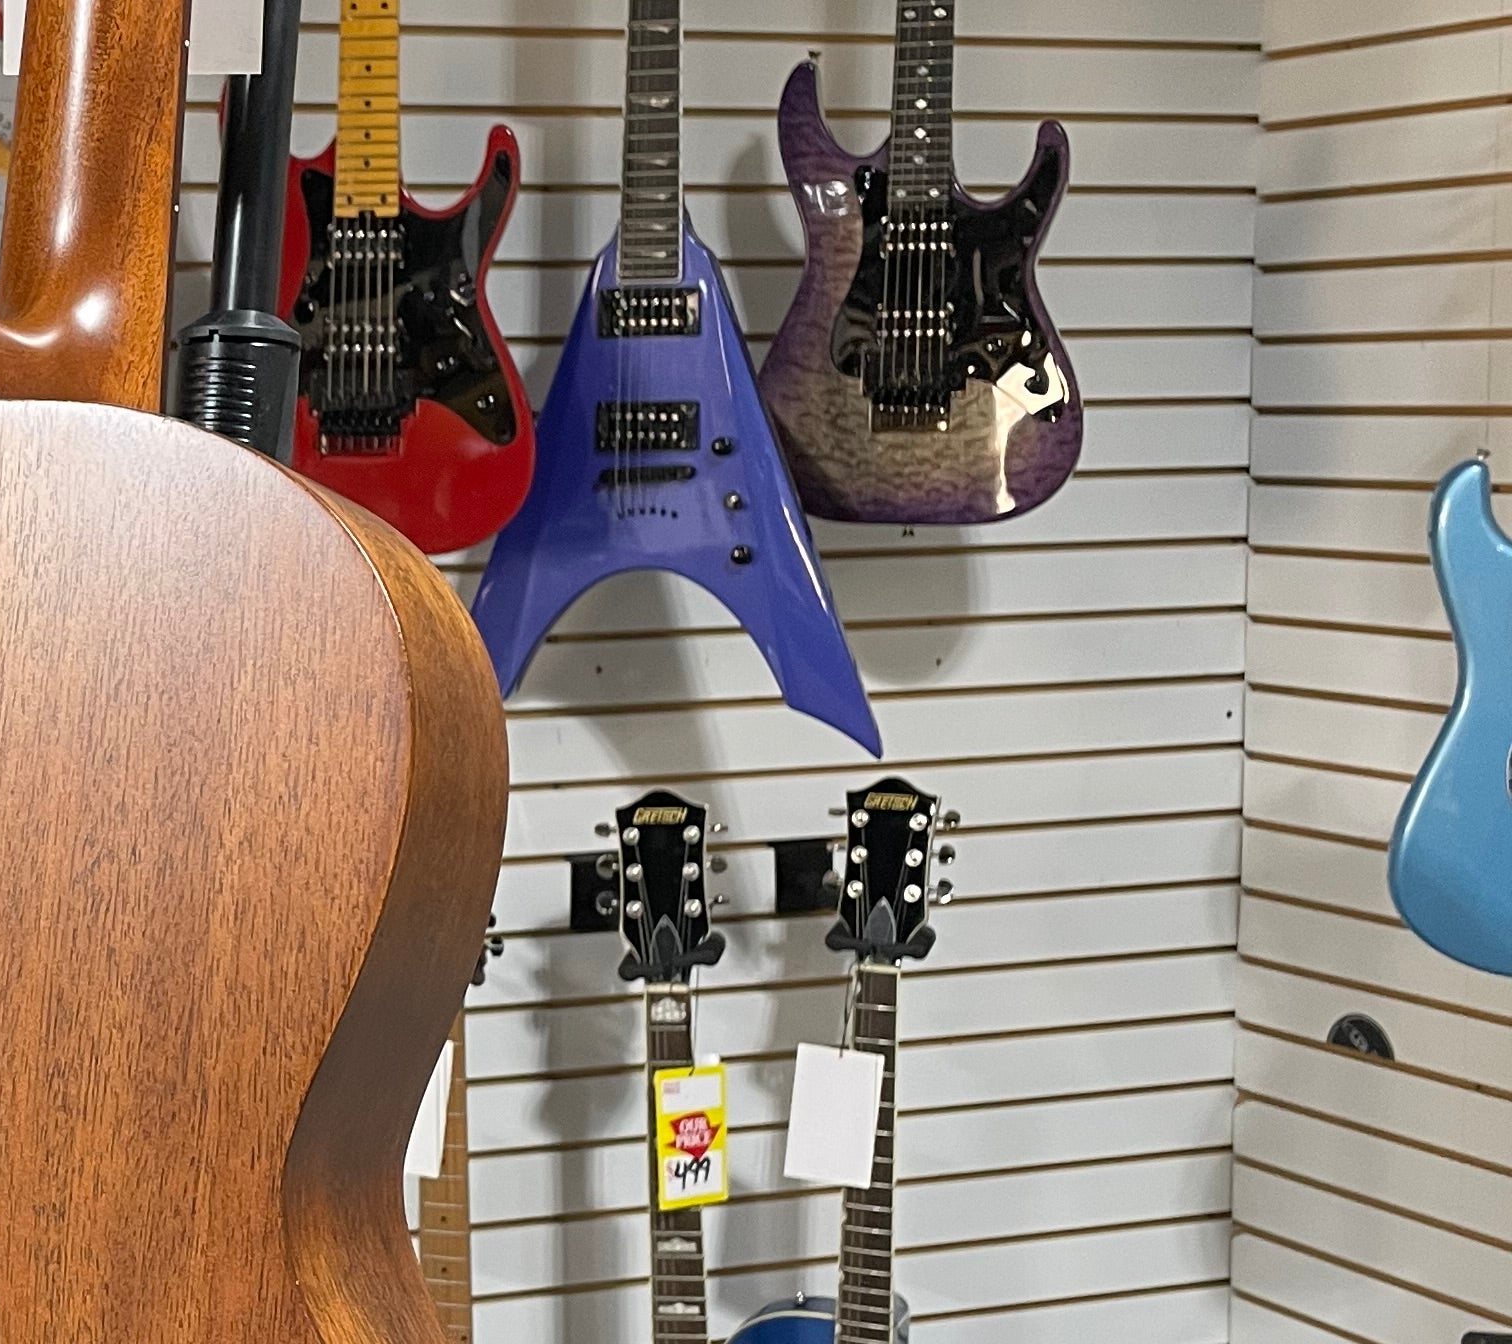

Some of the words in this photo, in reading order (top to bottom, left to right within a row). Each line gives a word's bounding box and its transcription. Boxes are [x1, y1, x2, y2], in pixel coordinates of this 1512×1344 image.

[864, 791, 920, 811] GRETSCH
[633, 806, 688, 825] GRETSCH
[679, 1117, 710, 1134] OUR
[676, 1131, 713, 1150] PRICE
